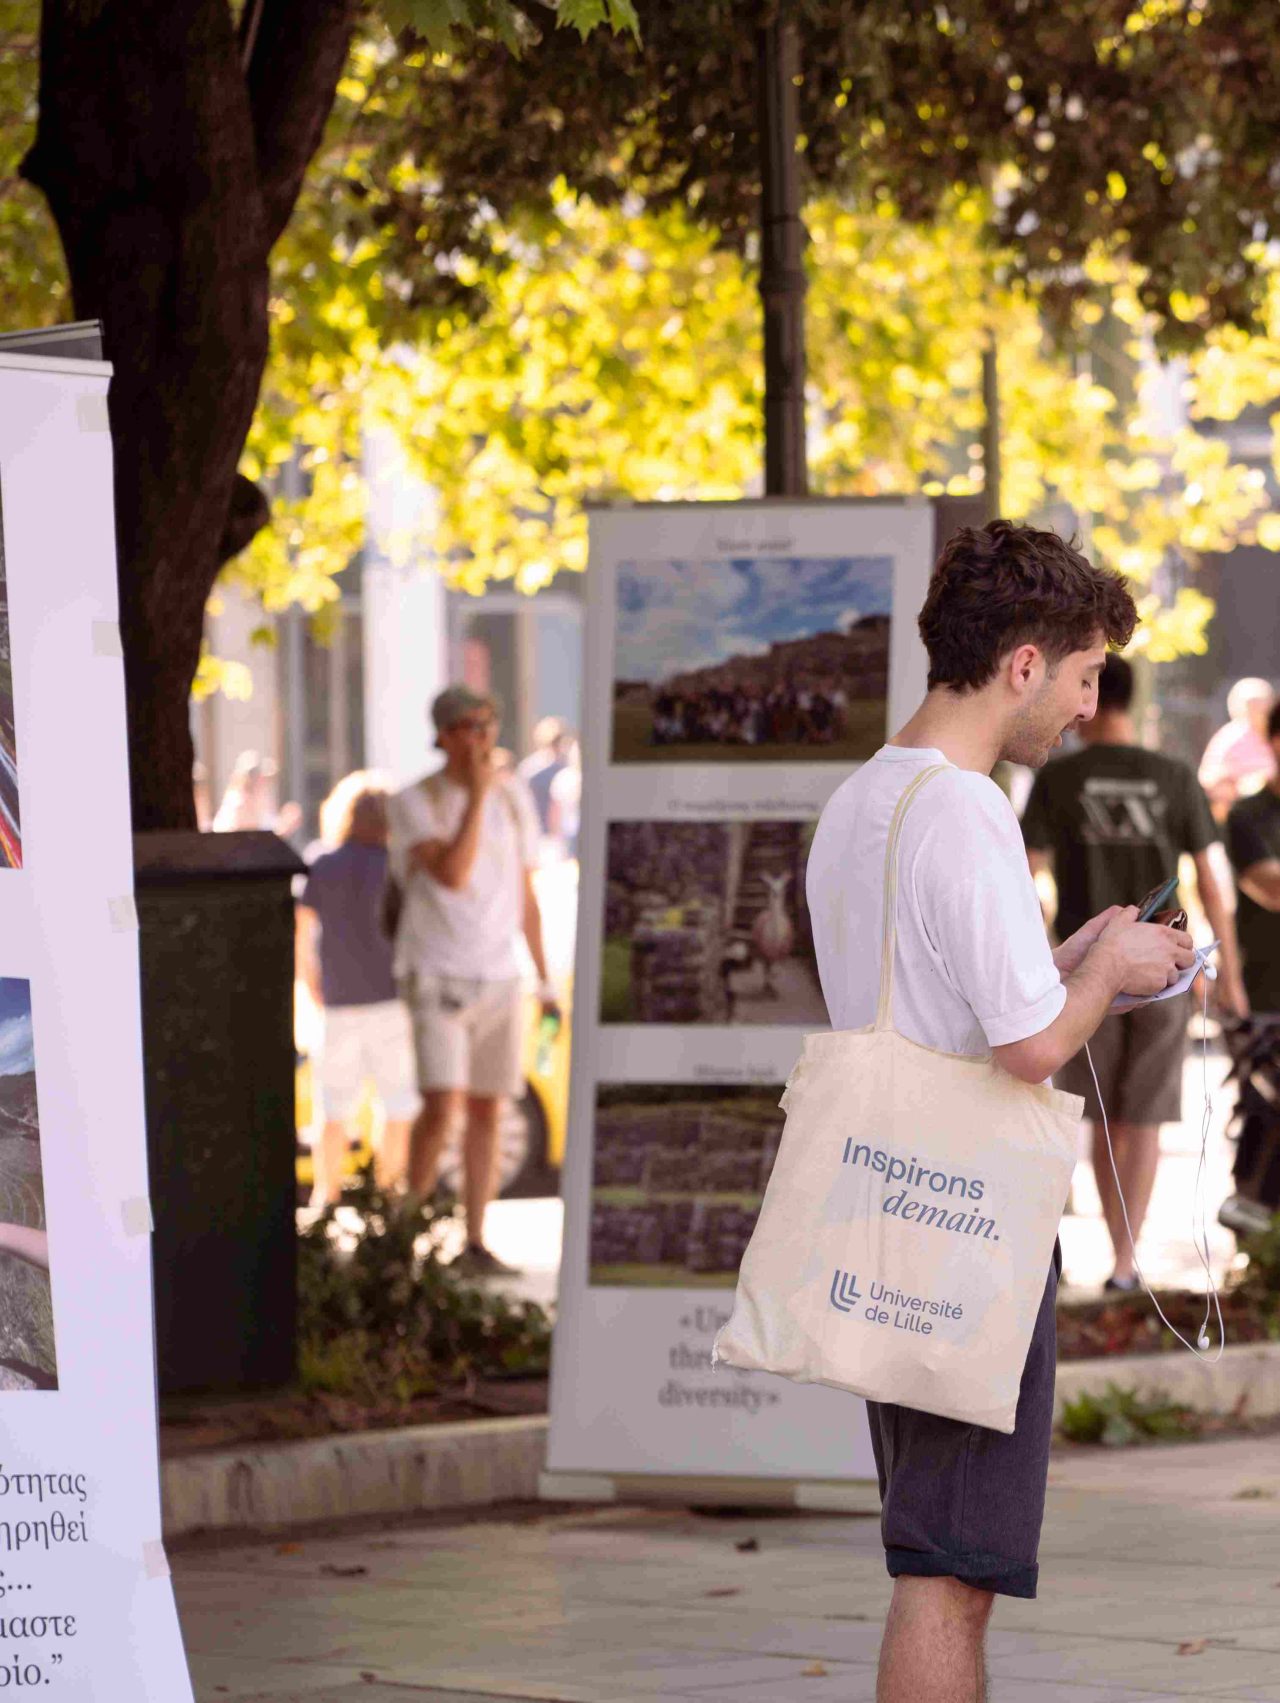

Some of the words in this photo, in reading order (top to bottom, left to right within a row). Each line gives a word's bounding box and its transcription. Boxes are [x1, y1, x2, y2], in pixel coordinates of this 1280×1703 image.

[842, 1136, 985, 1200] Inspirons
[882, 1189, 1000, 1241] demain.
[864, 1305, 889, 1325] de
[893, 1310, 933, 1335] Lille
[870, 1281, 963, 1320] Université
